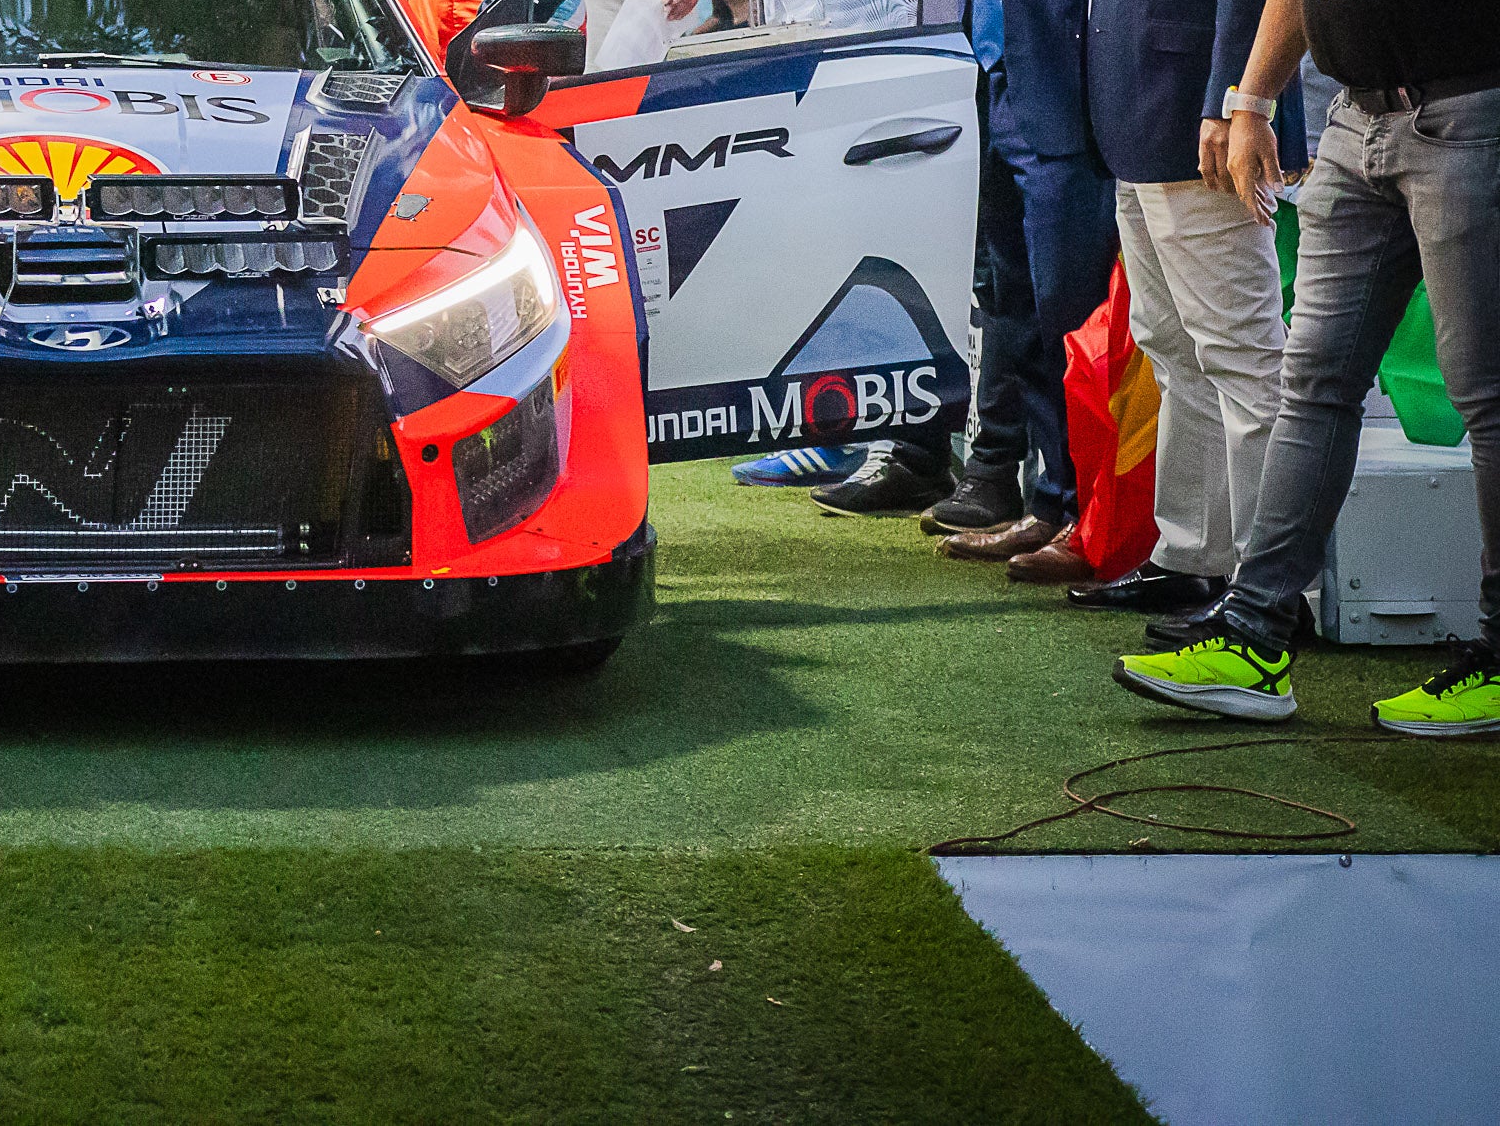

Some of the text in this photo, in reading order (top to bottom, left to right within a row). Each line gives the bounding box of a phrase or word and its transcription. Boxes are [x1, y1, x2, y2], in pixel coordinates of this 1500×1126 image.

[209, 72, 239, 84] E
[593, 127, 795, 183] MMR
[560, 241, 588, 319] HYUNDAI
[748, 367, 942, 443] MOBIS
